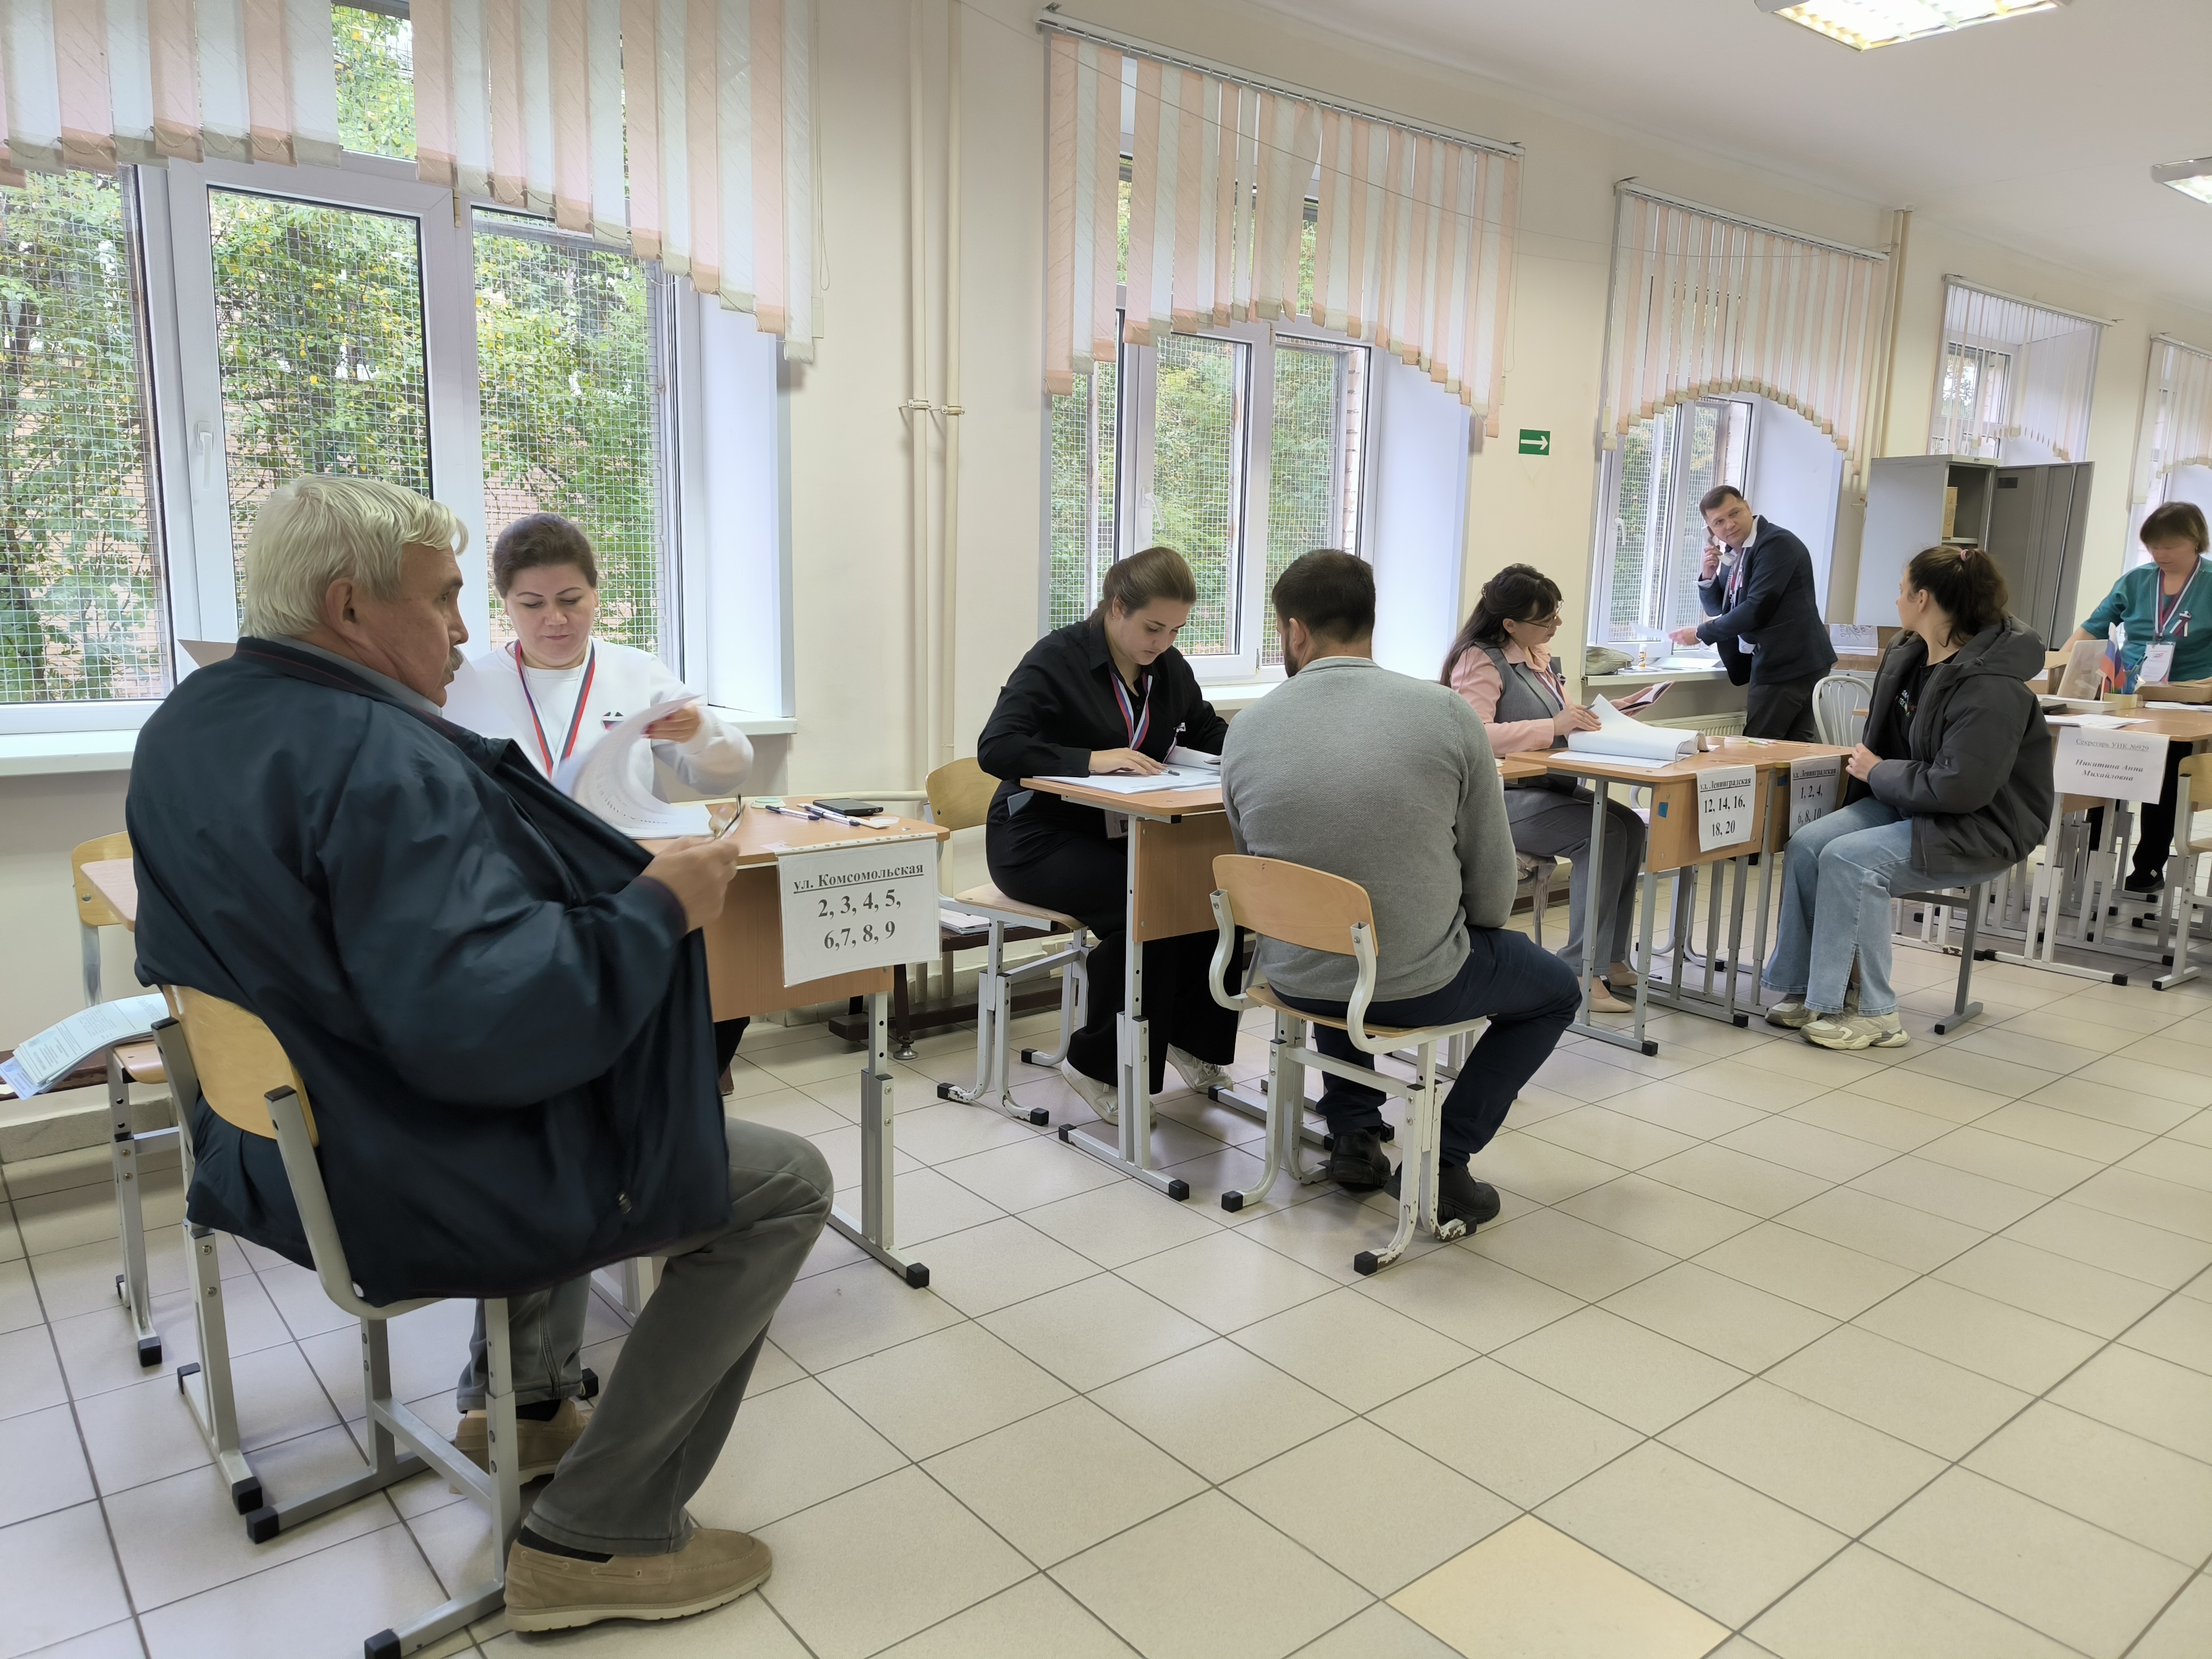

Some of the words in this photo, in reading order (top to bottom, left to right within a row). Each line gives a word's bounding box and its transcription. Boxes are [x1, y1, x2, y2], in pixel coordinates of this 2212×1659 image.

[1709, 778, 1751, 789] Ленинградская
[2082, 770, 2134, 781] Михайловна
[1800, 786, 1806, 800] 1,
[1808, 785, 1814, 799] 2,
[1816, 784, 1823, 799] 4,
[1704, 799, 1715, 814] 12,
[1718, 796, 1730, 812] 14,
[1734, 794, 1745, 810] 16,
[1798, 811, 1803, 825] 6,
[1712, 822, 1723, 838] 18,
[1725, 820, 1735, 834] 20
[794, 879, 813, 892] ул.
[818, 864, 923, 887] Комсомольская
[818, 899, 834, 920] 2,
[840, 895, 857, 916] 3,
[863, 892, 879, 913] 4,
[885, 889, 901, 909] 5,
[862, 924, 879, 945] 8,
[885, 920, 895, 939] 9
